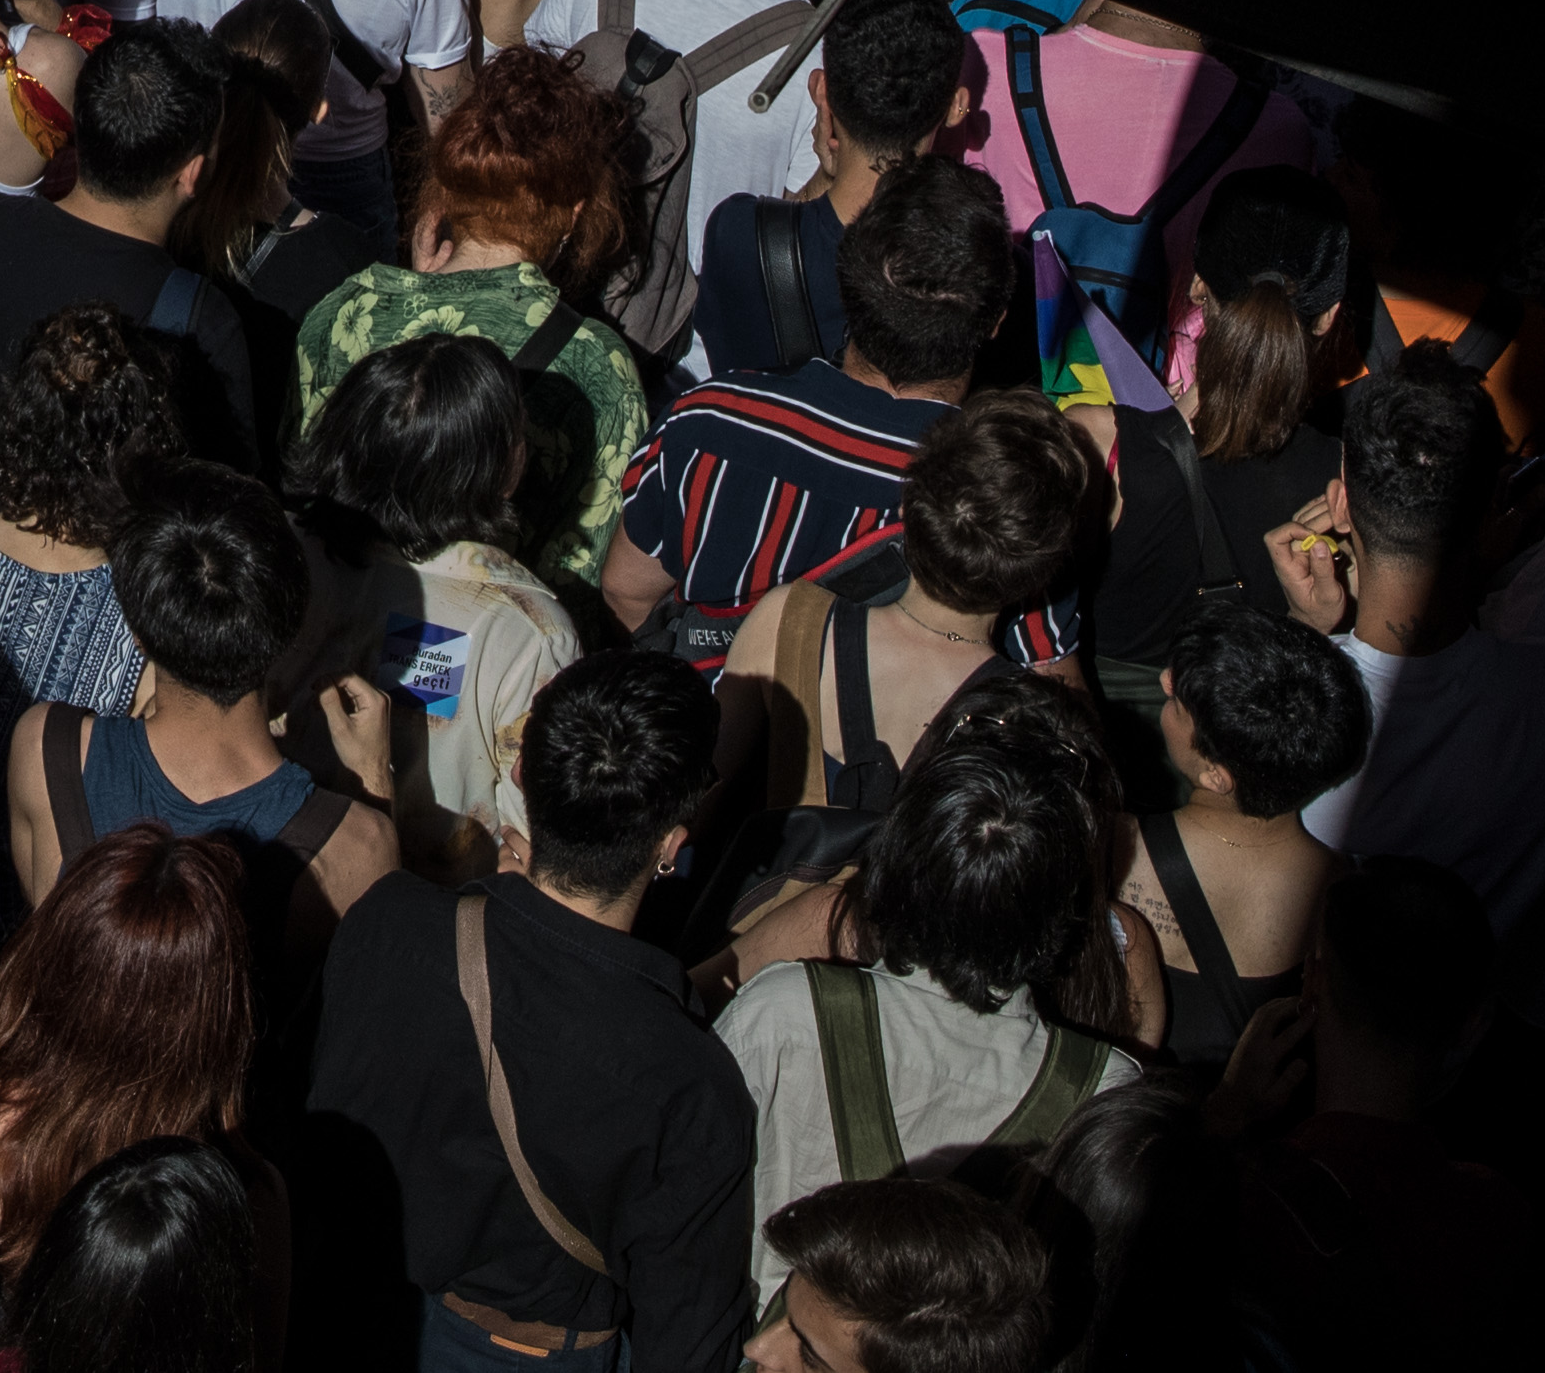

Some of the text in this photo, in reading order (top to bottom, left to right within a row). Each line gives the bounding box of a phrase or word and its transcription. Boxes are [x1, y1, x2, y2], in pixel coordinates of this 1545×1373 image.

[412, 647, 452, 664] Buradan
[389, 653, 452, 677] TRANS ERKEK
[413, 674, 450, 691] geçti
